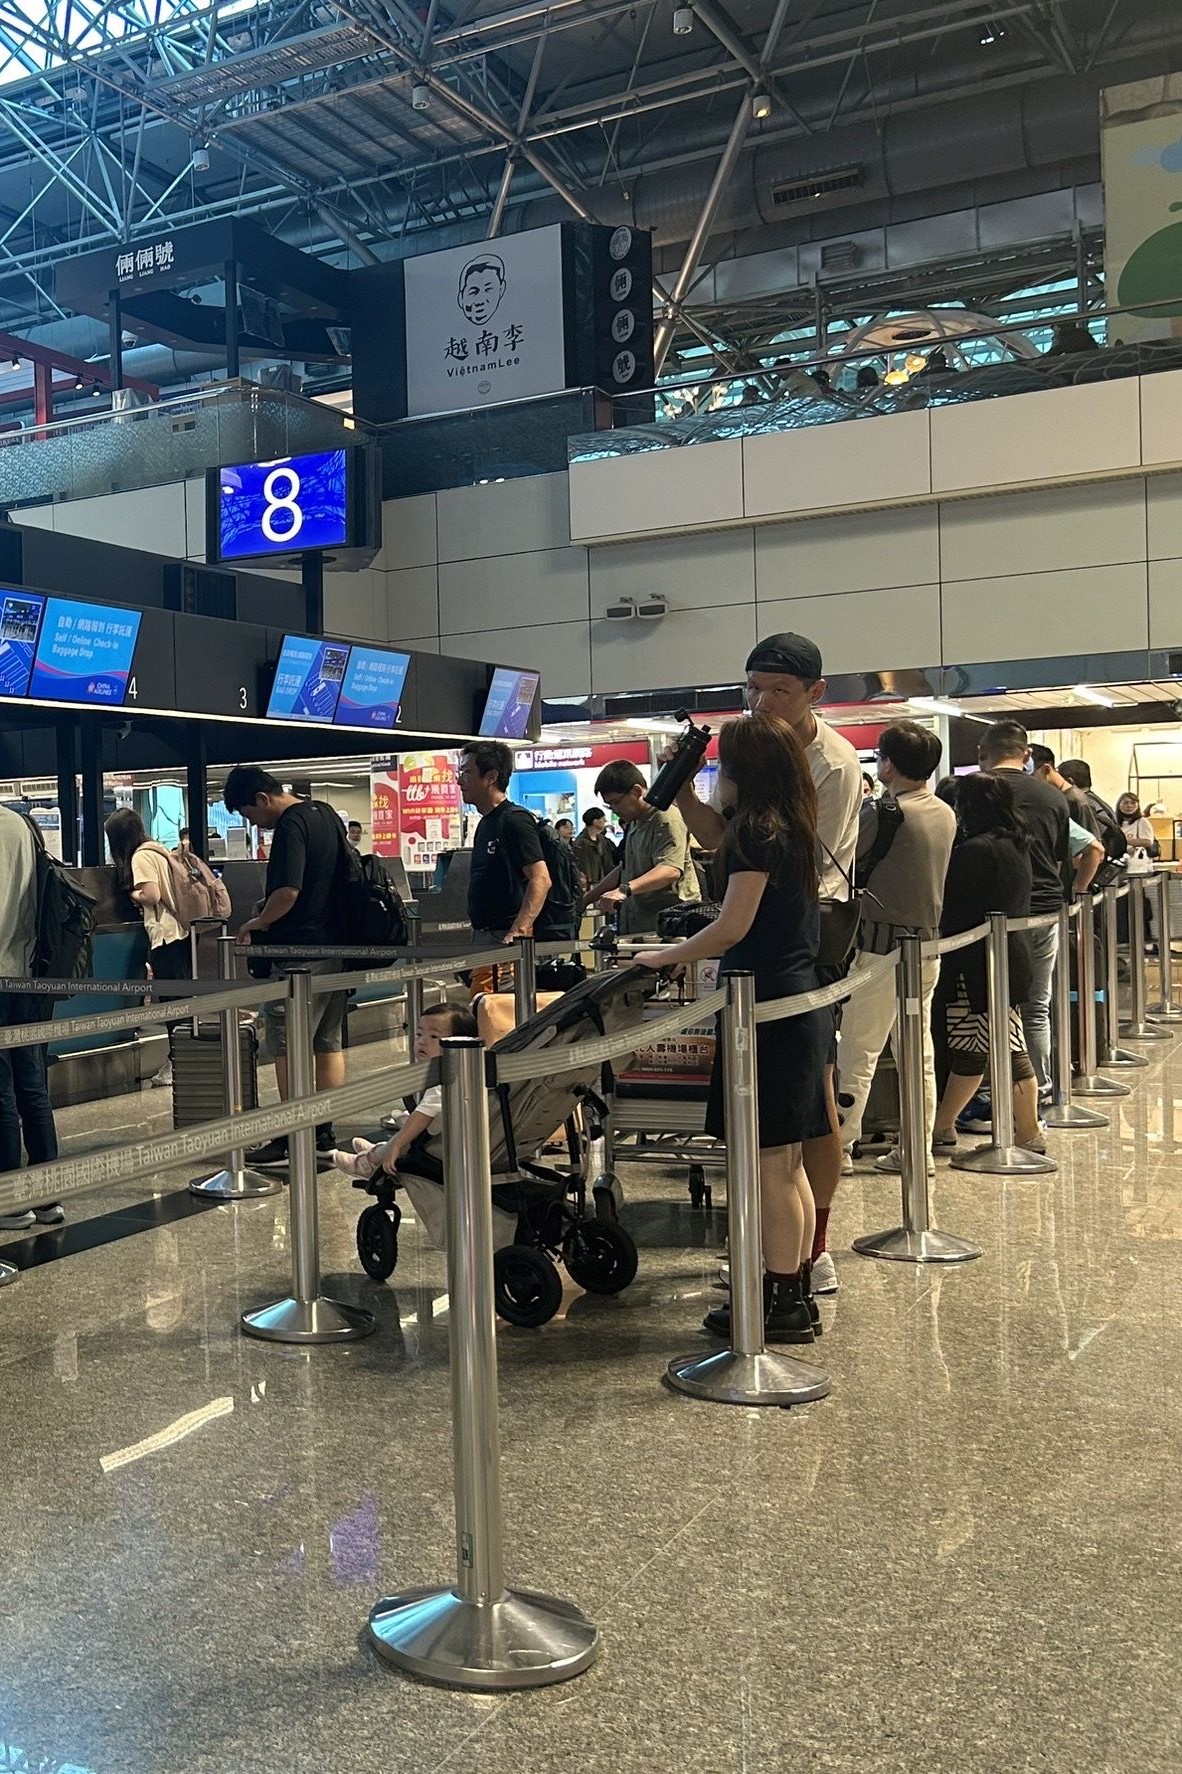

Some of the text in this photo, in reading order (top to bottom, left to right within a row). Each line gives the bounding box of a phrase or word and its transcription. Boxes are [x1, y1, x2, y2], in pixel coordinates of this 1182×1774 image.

[115, 241, 174, 276] 倆倆號
[444, 324, 524, 361] 越南李
[262, 467, 303, 543] 8
[128, 676, 138, 700] 4
[239, 687, 248, 710] 3
[395, 705, 403, 724] 2
[5, 979, 31, 989] Taiwan
[33, 980, 66, 992] Taoyuan
[68, 981, 119, 991] International
[122, 982, 152, 994] Airport
[71, 1020, 95, 1033] Taiwan
[96, 1014, 124, 1029] Taoyuan
[125, 1009, 168, 1024] International
[167, 1004, 190, 1019] Airport
[136, 1141, 179, 1167] Taiwan
[180, 1127, 229, 1155] Taoyuan
[230, 1107, 297, 1140] International
[295, 1099, 333, 1123] Airport
